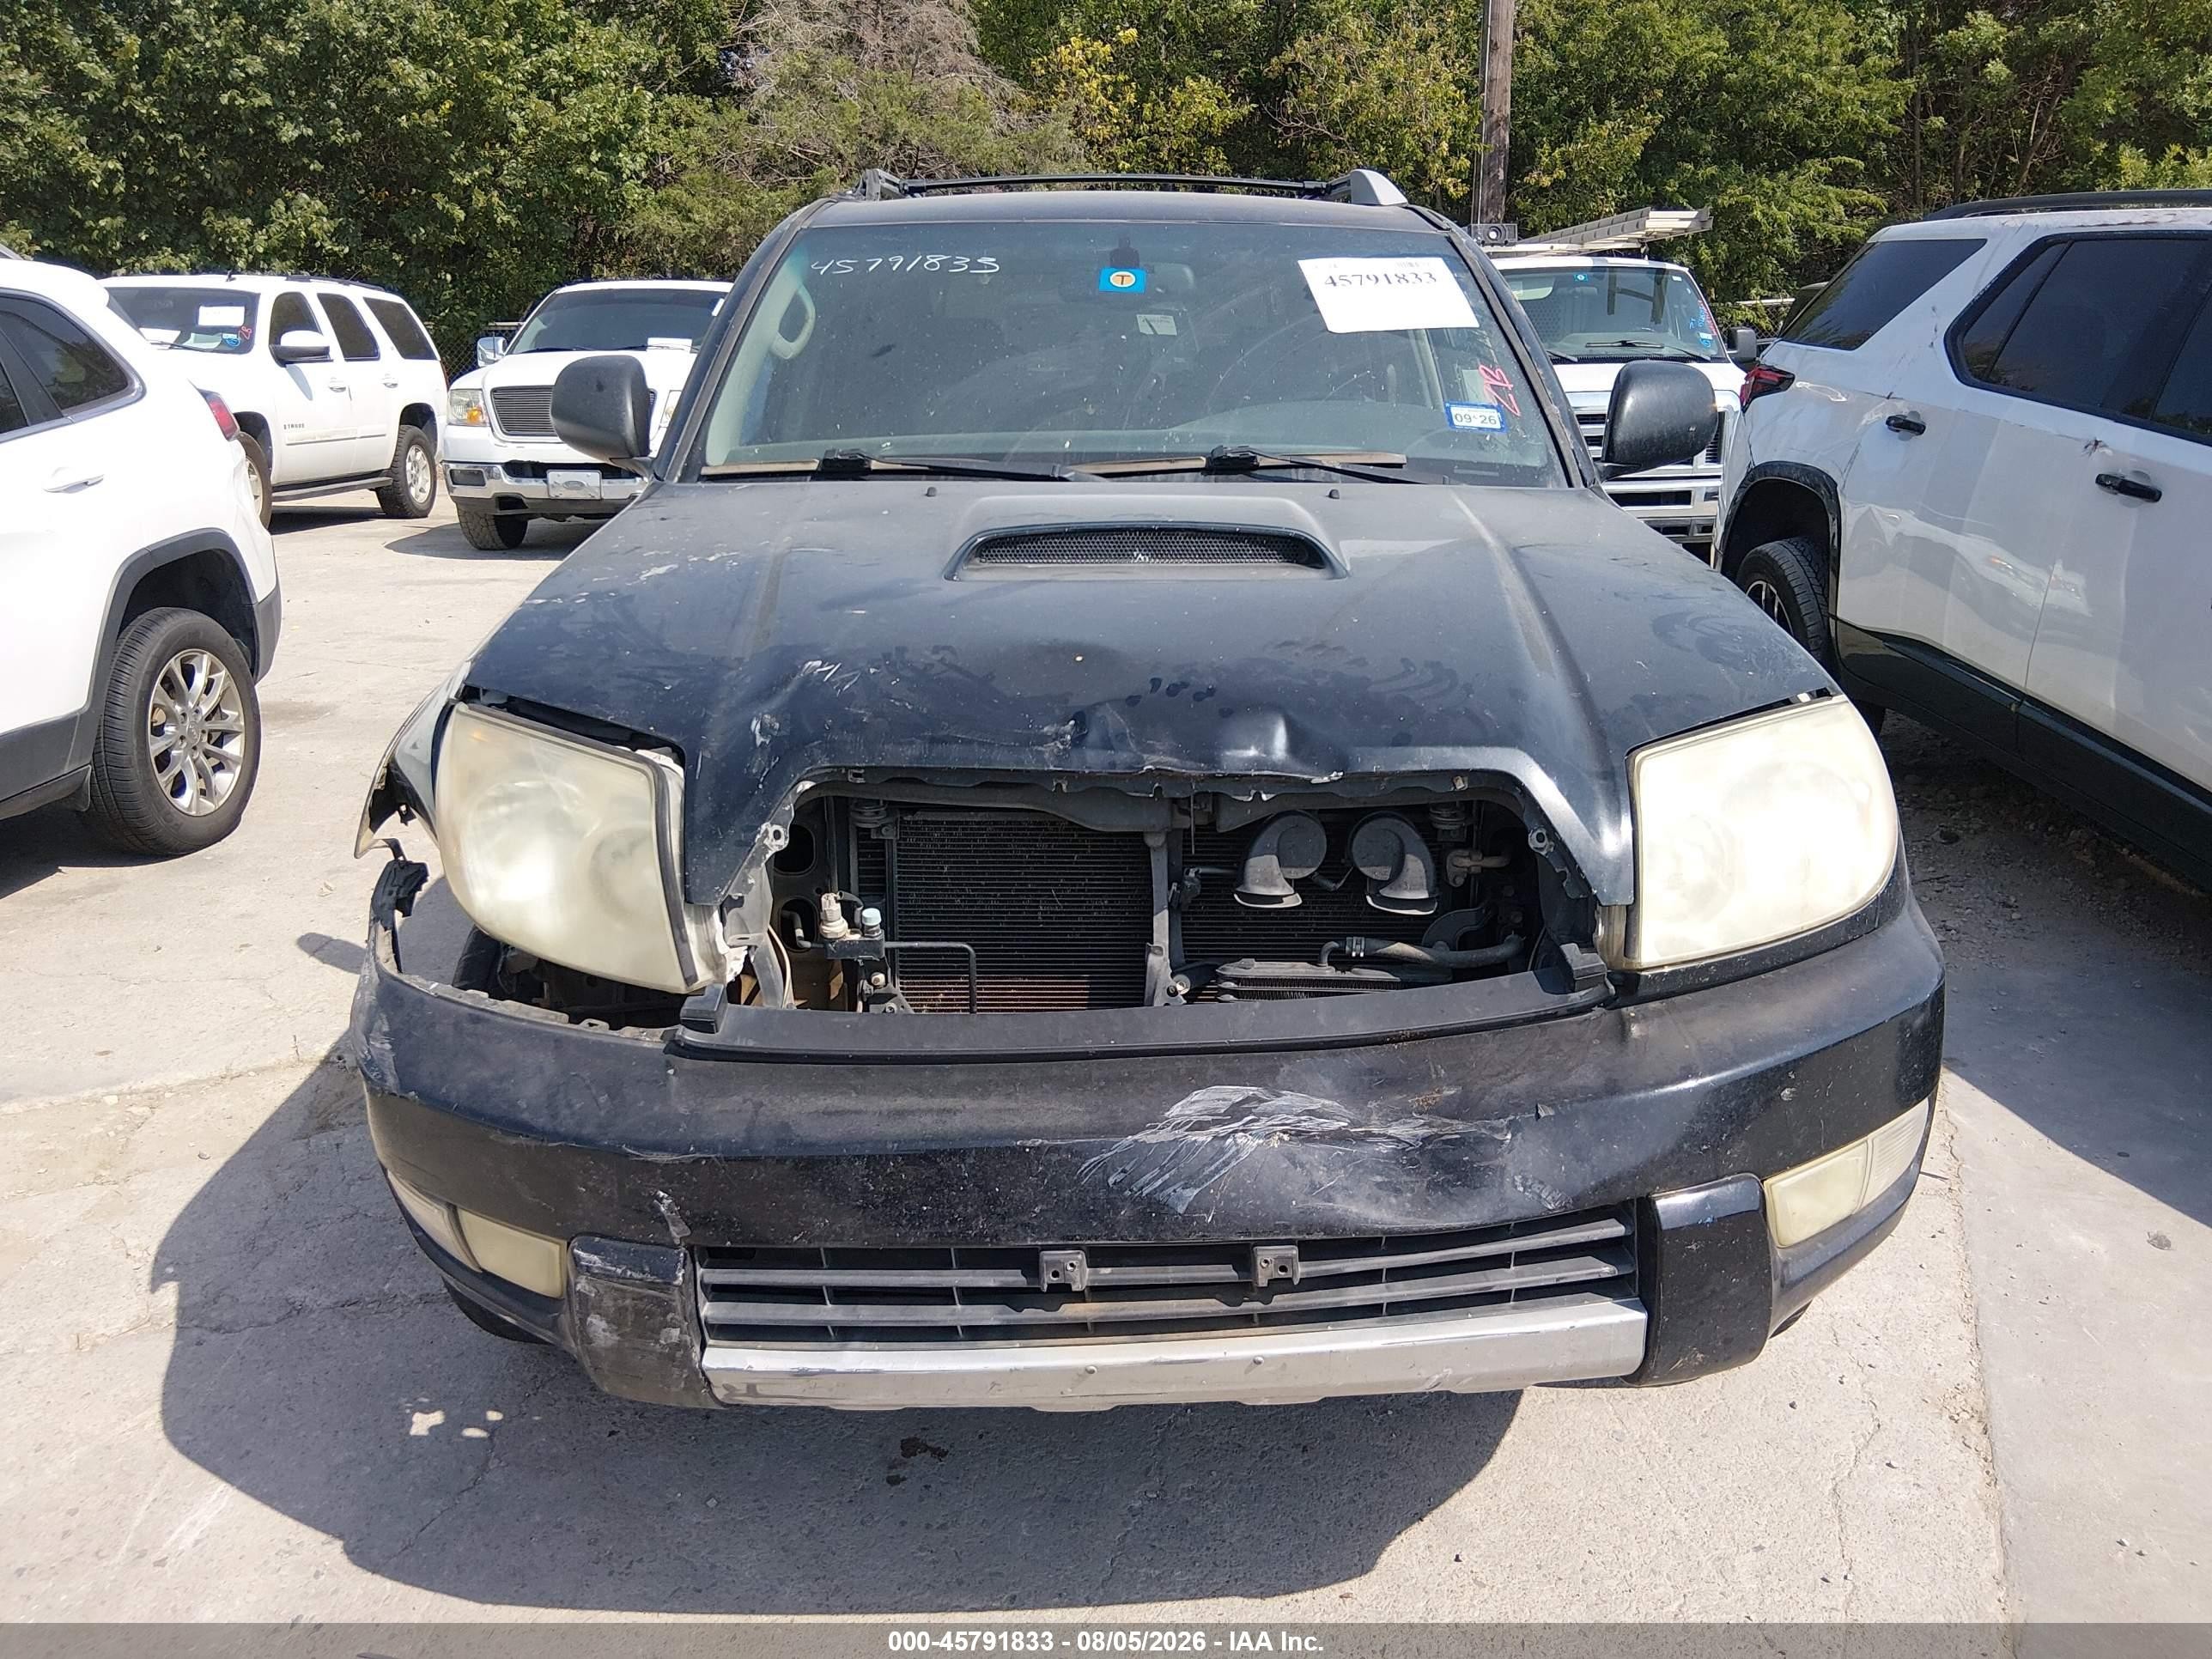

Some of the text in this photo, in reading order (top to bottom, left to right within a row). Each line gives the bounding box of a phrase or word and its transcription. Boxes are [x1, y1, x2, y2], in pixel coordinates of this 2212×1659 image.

[811, 255, 1000, 275] 45791833
[1115, 274, 1132, 286] T
[1324, 271, 1437, 288] 45791833
[1455, 413, 1498, 425] 09 26
